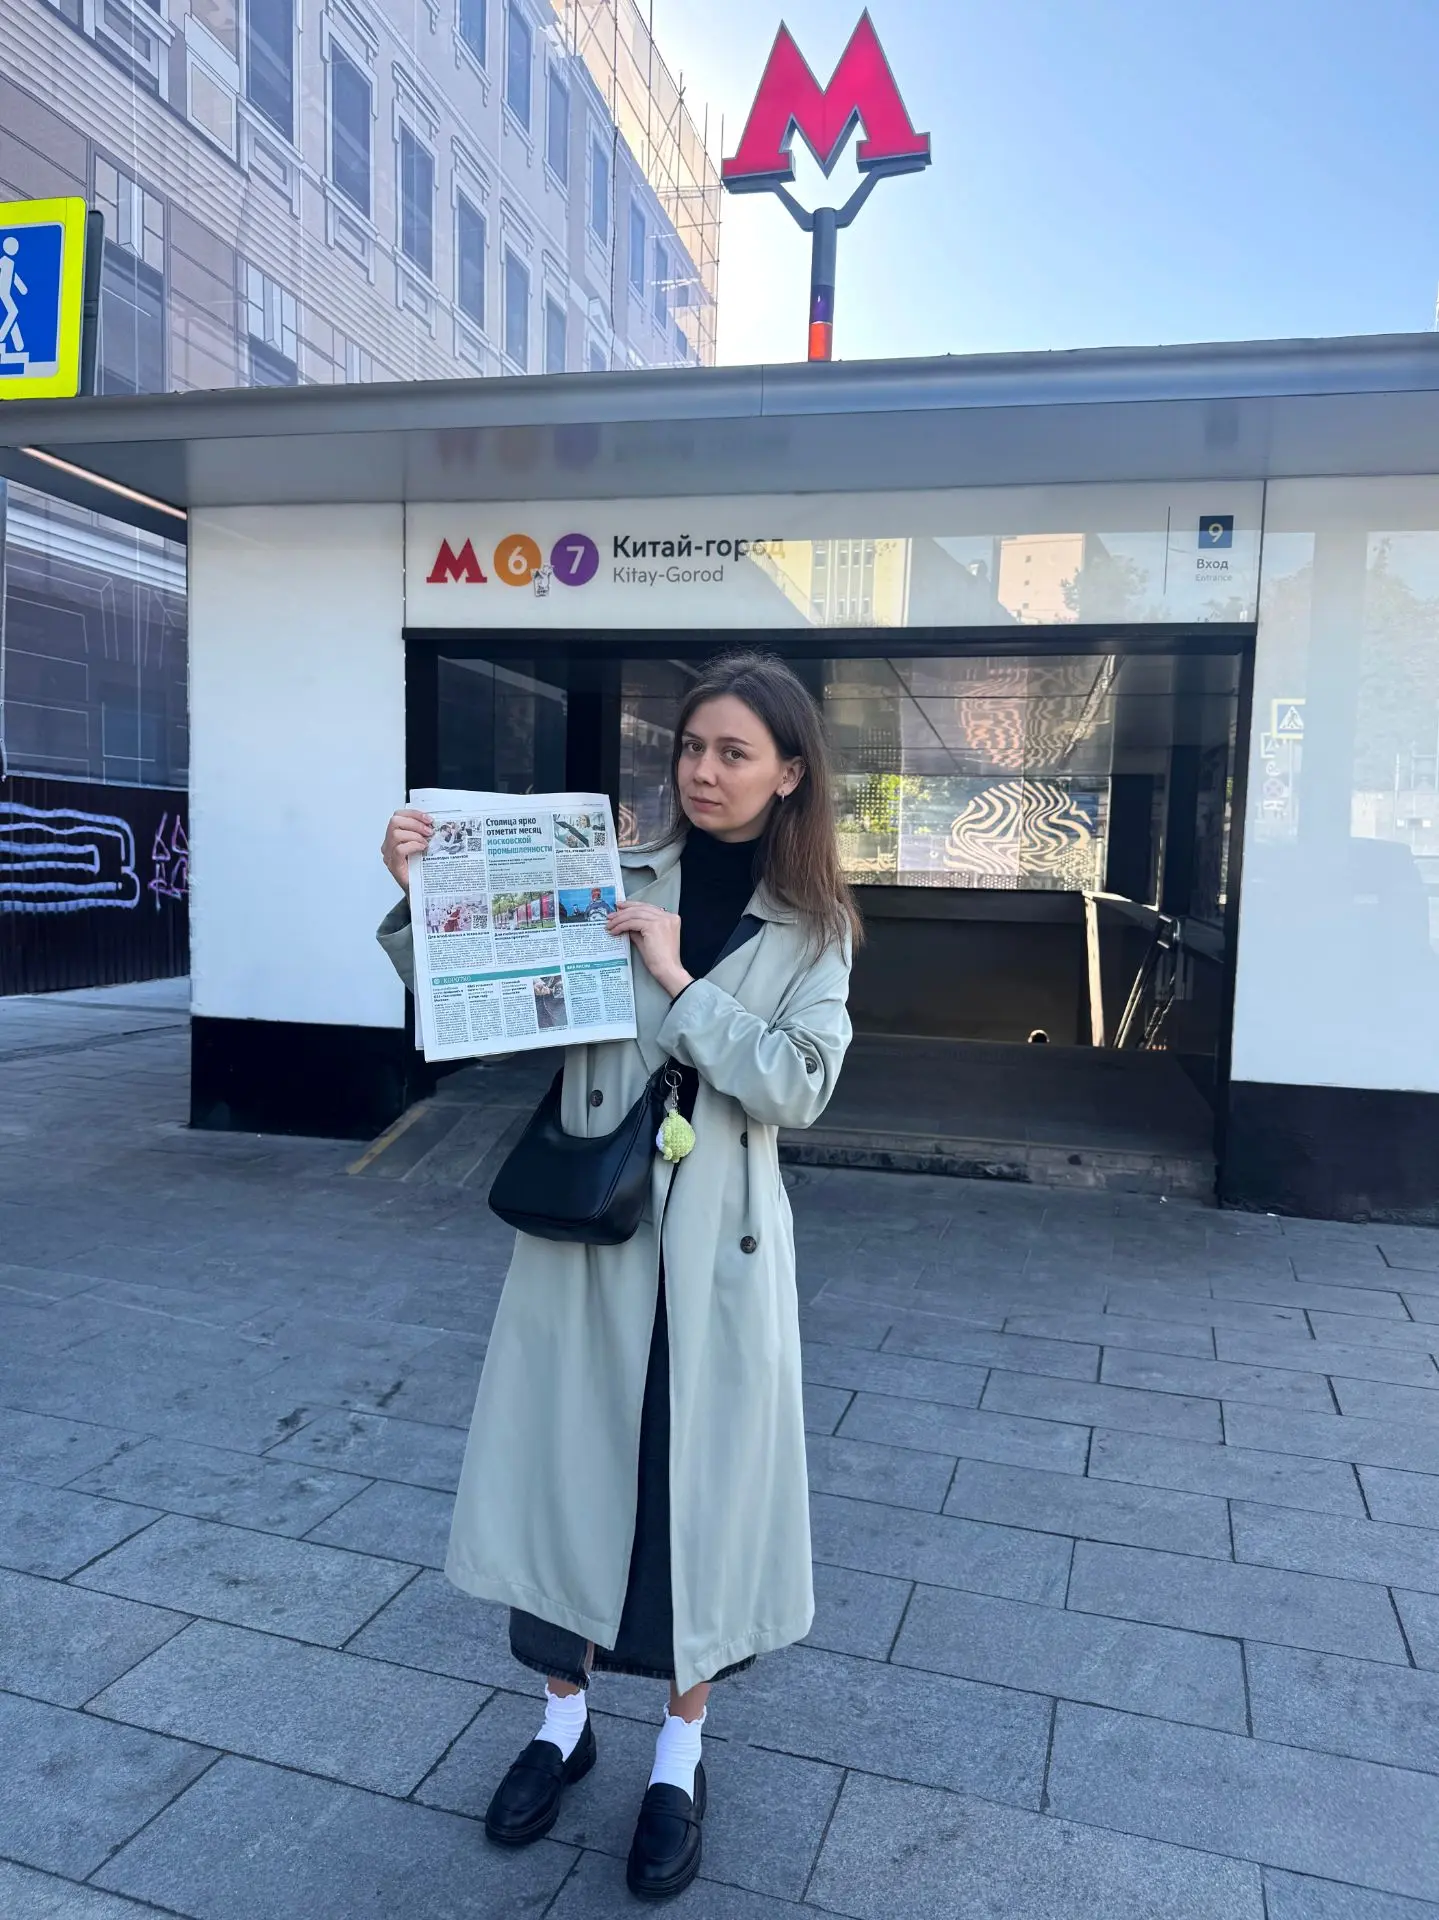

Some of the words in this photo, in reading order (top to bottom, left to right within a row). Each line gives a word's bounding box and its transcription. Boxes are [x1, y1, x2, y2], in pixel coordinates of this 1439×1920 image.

[722, 6, 931, 182] М
[1208, 523, 1223, 543] 9
[613, 534, 786, 562] Китай-город
[426, 538, 487, 583] М
[508, 546, 527, 575] 6
[566, 545, 585, 574] 7
[1196, 558, 1229, 570] Вход
[613, 565, 724, 586] Kitay-Gorod
[1195, 573, 1233, 582] Entrance
[485, 818, 517, 827] Столица
[518, 817, 537, 826] ярко
[486, 828, 517, 836] отметит
[487, 835, 532, 845] московской
[488, 845, 553, 857] промышленности
